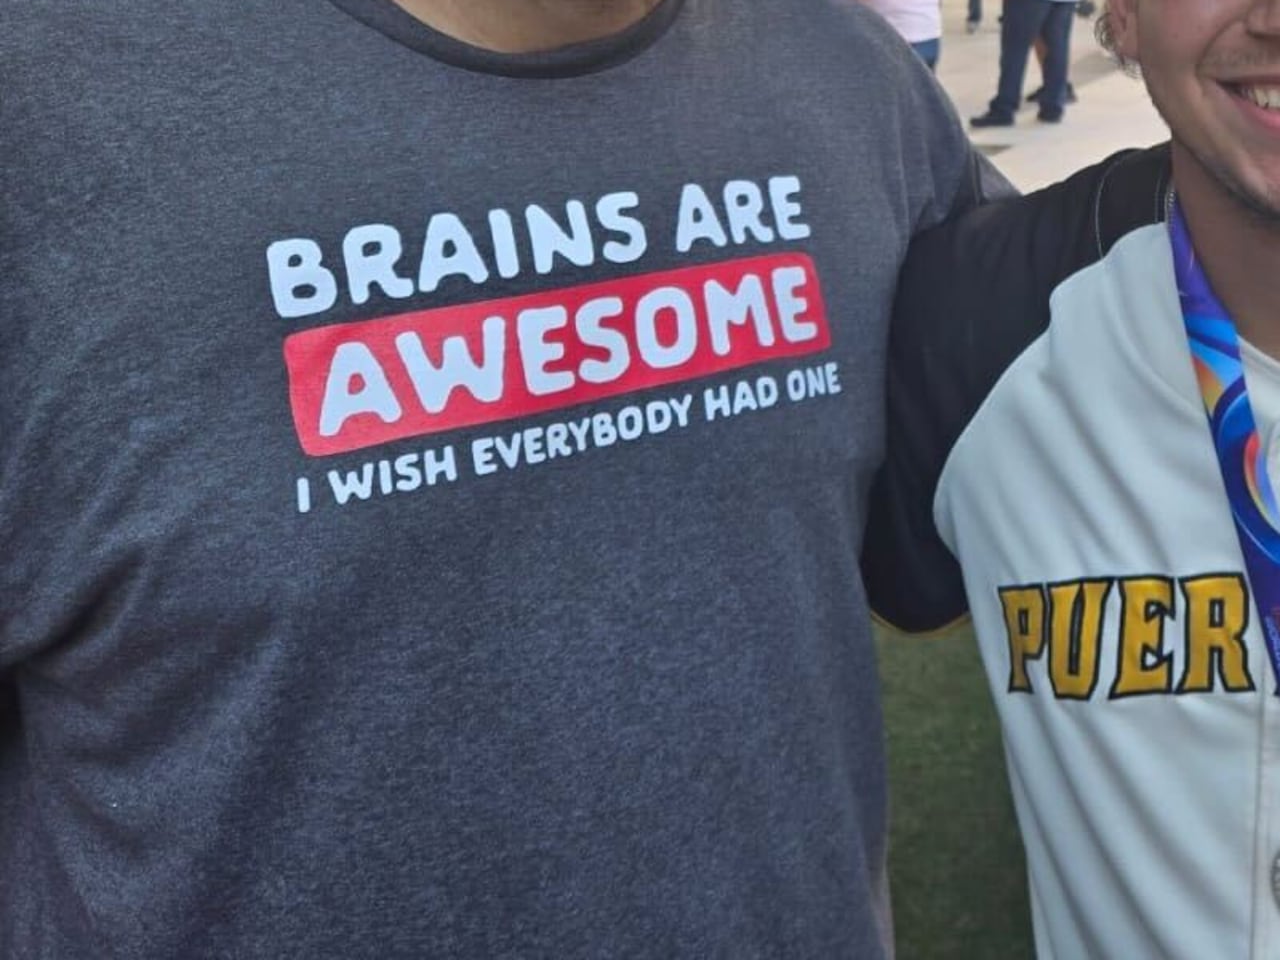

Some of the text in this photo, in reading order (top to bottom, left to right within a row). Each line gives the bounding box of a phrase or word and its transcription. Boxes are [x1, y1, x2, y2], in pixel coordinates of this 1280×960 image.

[266, 176, 811, 318] BRAINS ARE
[319, 267, 818, 437] AWESOME
[297, 362, 842, 513] I WISH EVERYBODY HAD ONE
